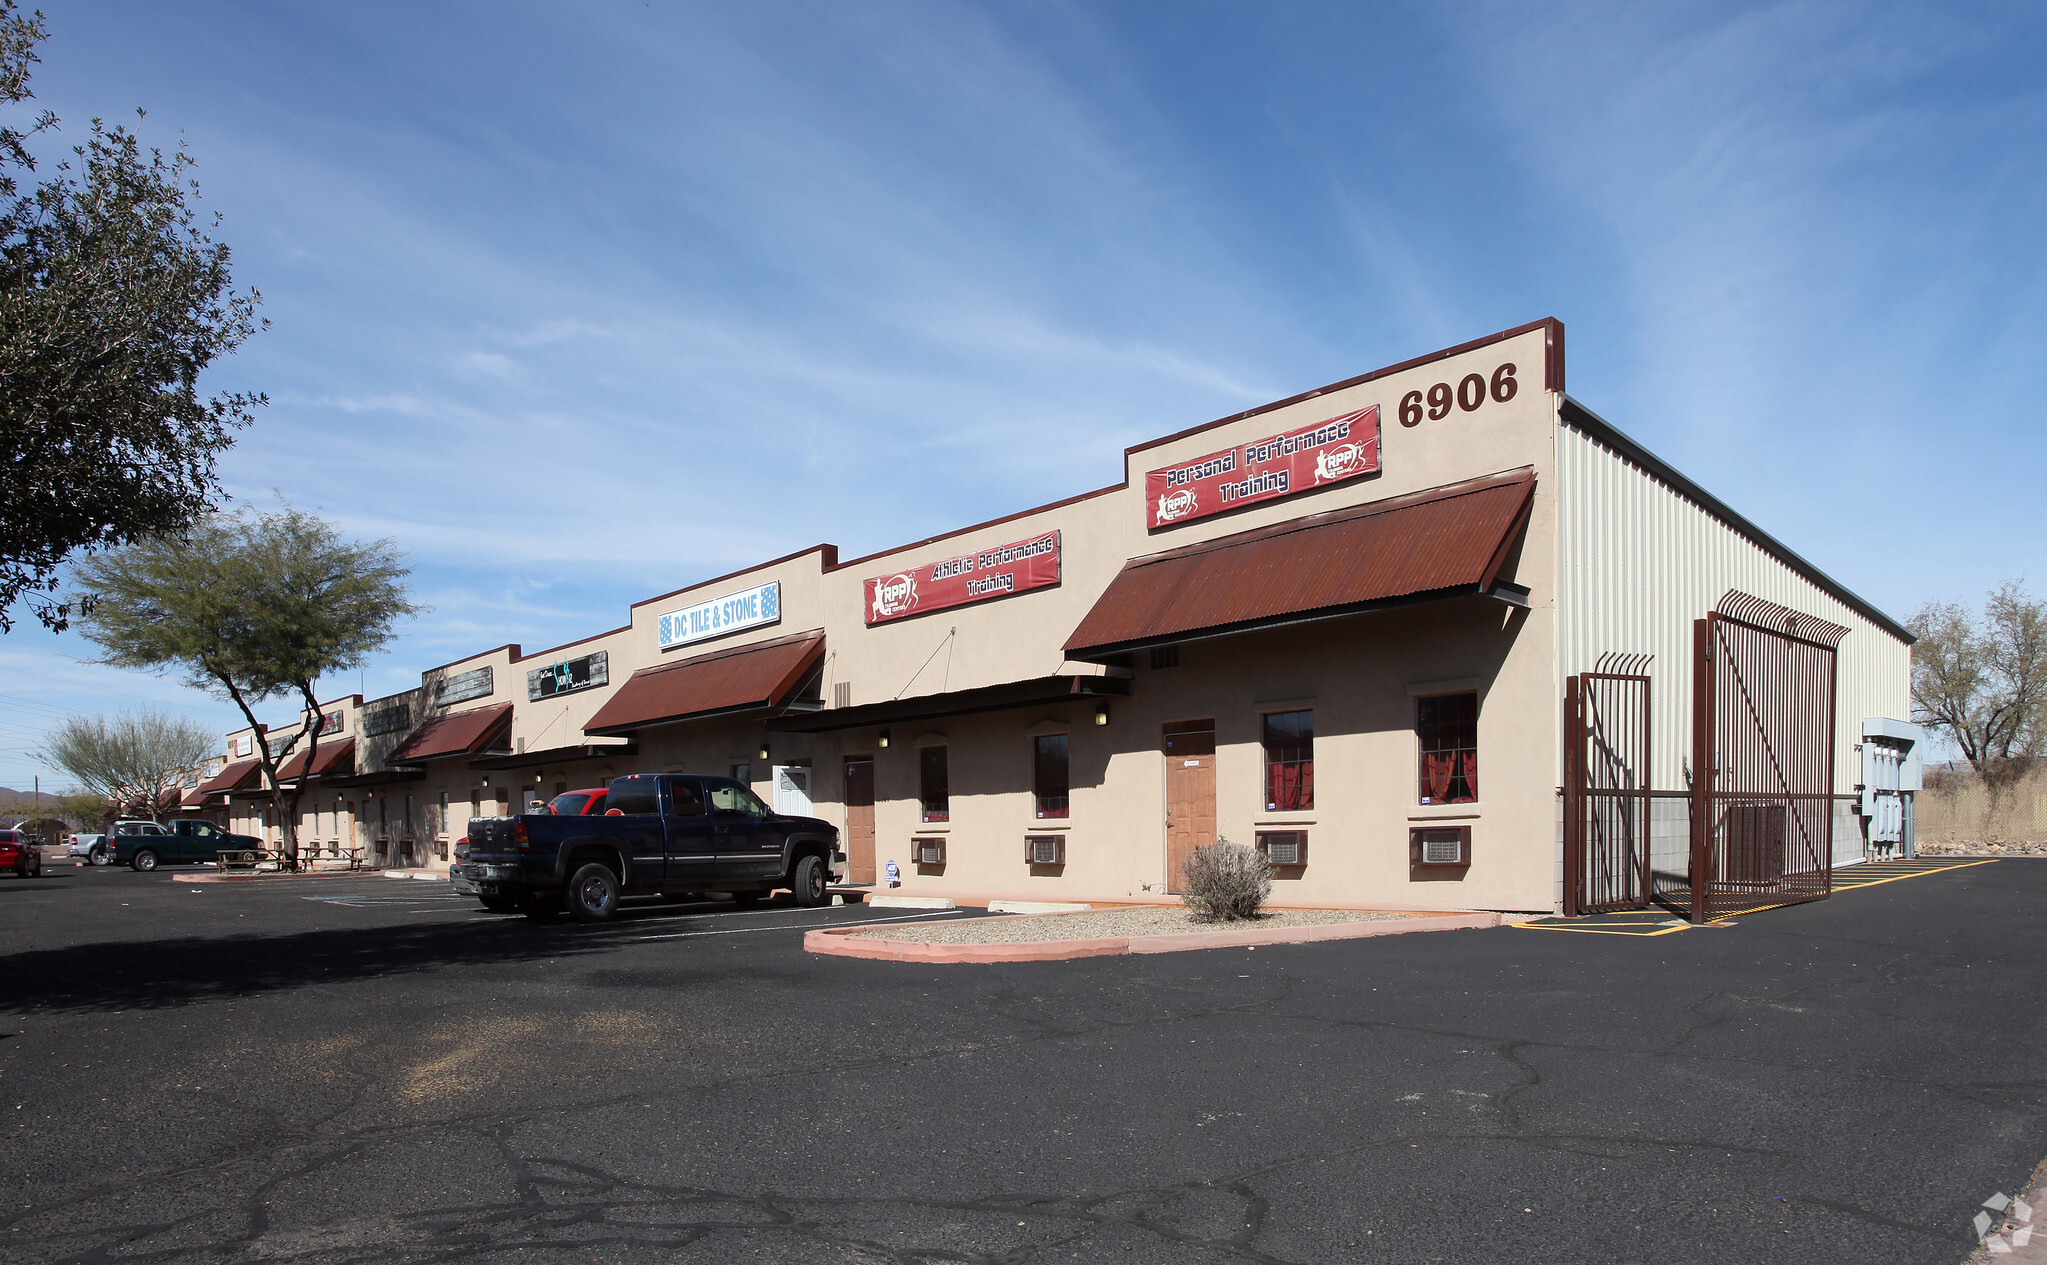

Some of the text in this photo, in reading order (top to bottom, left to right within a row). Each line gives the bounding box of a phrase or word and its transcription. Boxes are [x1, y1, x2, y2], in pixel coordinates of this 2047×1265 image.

[1398, 362, 1518, 428] 6906
[1166, 421, 1351, 489] Personal Performace
[1327, 450, 1353, 469] RPP
[1167, 495, 1188, 511] RPP
[1219, 469, 1290, 503] Training
[931, 538, 1054, 581] Athletic Performance
[884, 582, 907, 603] RPP
[967, 572, 1014, 596] Training
[674, 594, 758, 638] DC TILE & STONE
